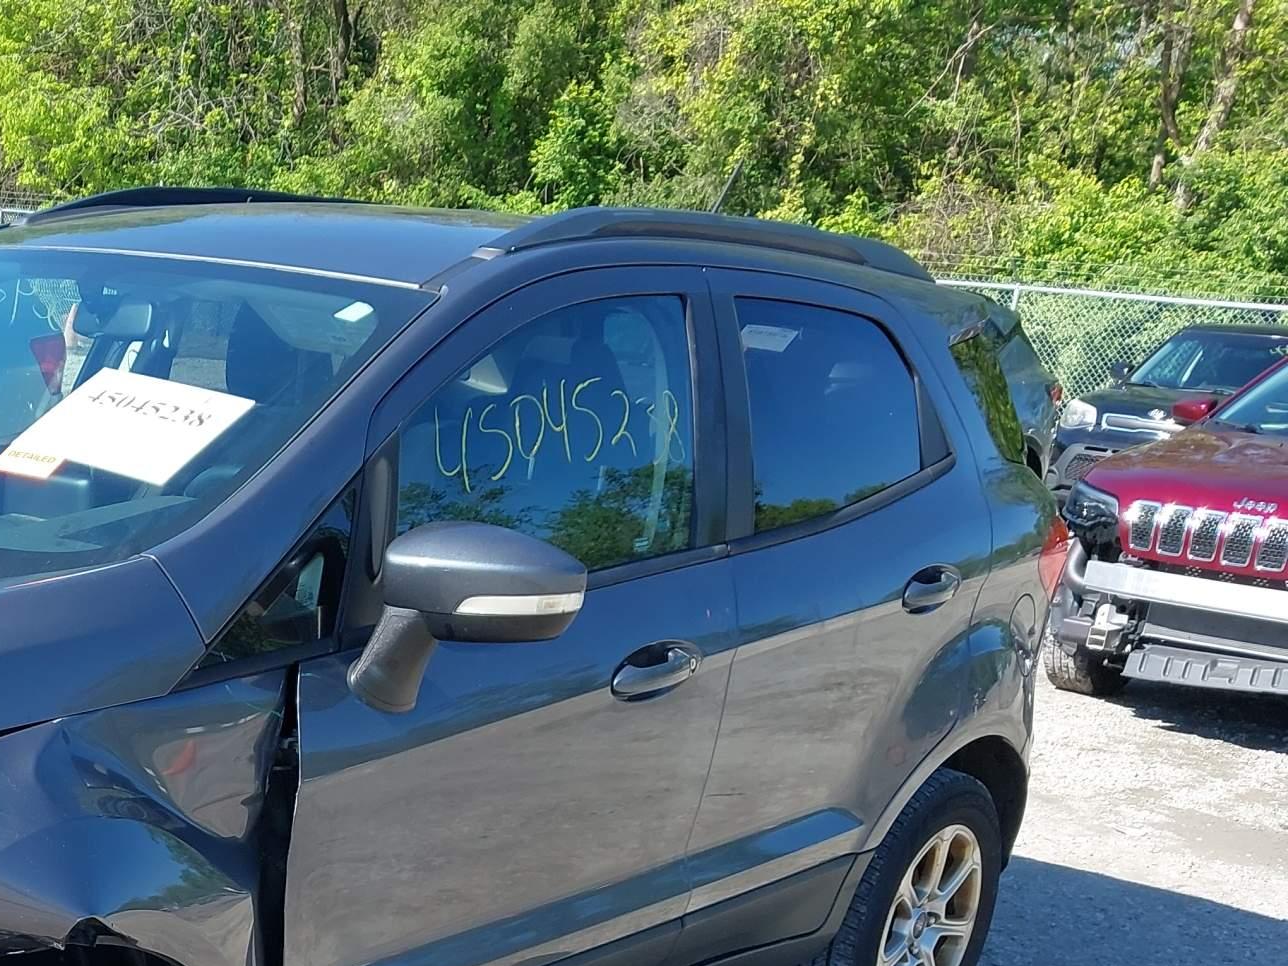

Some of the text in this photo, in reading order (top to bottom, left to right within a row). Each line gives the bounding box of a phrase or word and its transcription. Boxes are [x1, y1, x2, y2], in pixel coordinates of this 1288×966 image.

[87, 389, 213, 428] 45045238
[8, 450, 57, 464] DETAILED
[1232, 497, 1279, 514] Jeep
